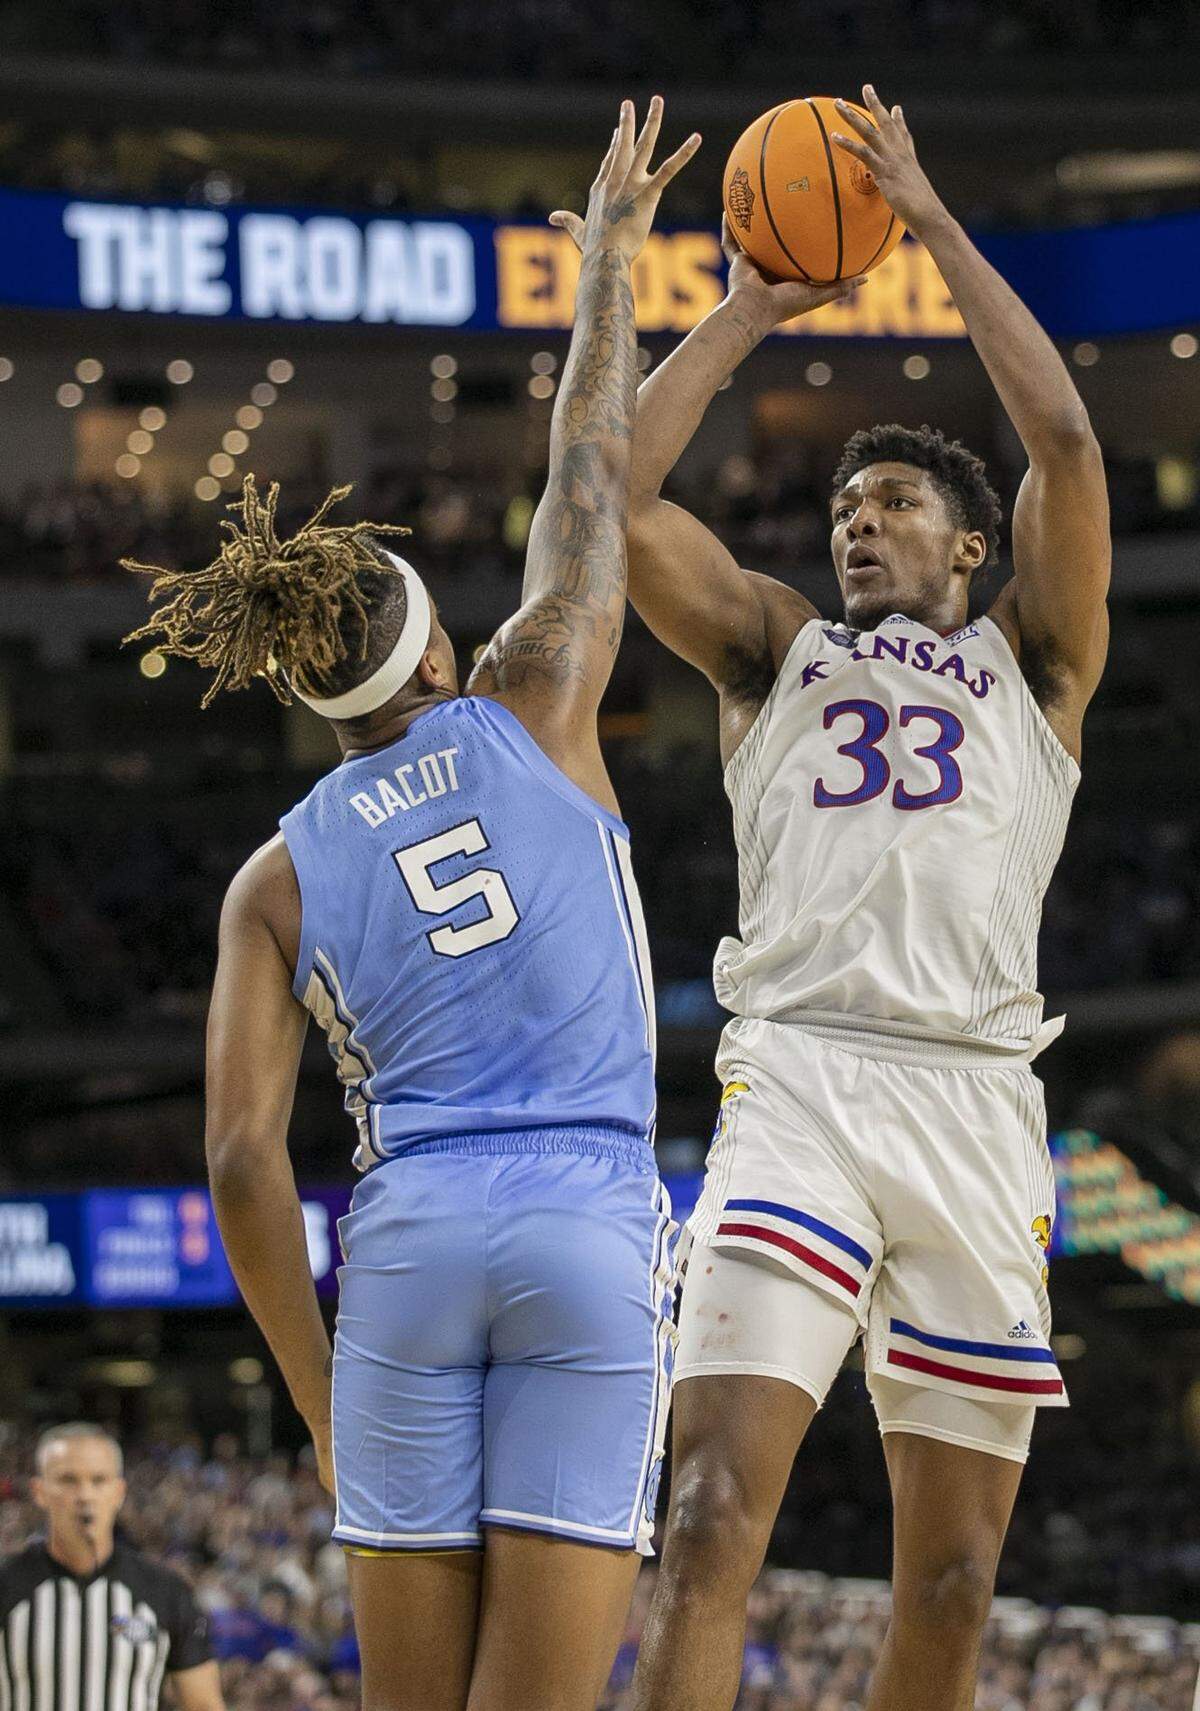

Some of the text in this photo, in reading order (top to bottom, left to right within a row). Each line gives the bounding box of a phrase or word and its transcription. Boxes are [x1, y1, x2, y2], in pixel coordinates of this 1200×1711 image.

[63, 202, 232, 316] THE
[238, 213, 477, 327] ROAD
[349, 748, 460, 829] BACOT
[813, 699, 965, 811] 33
[391, 816, 522, 960] 5
